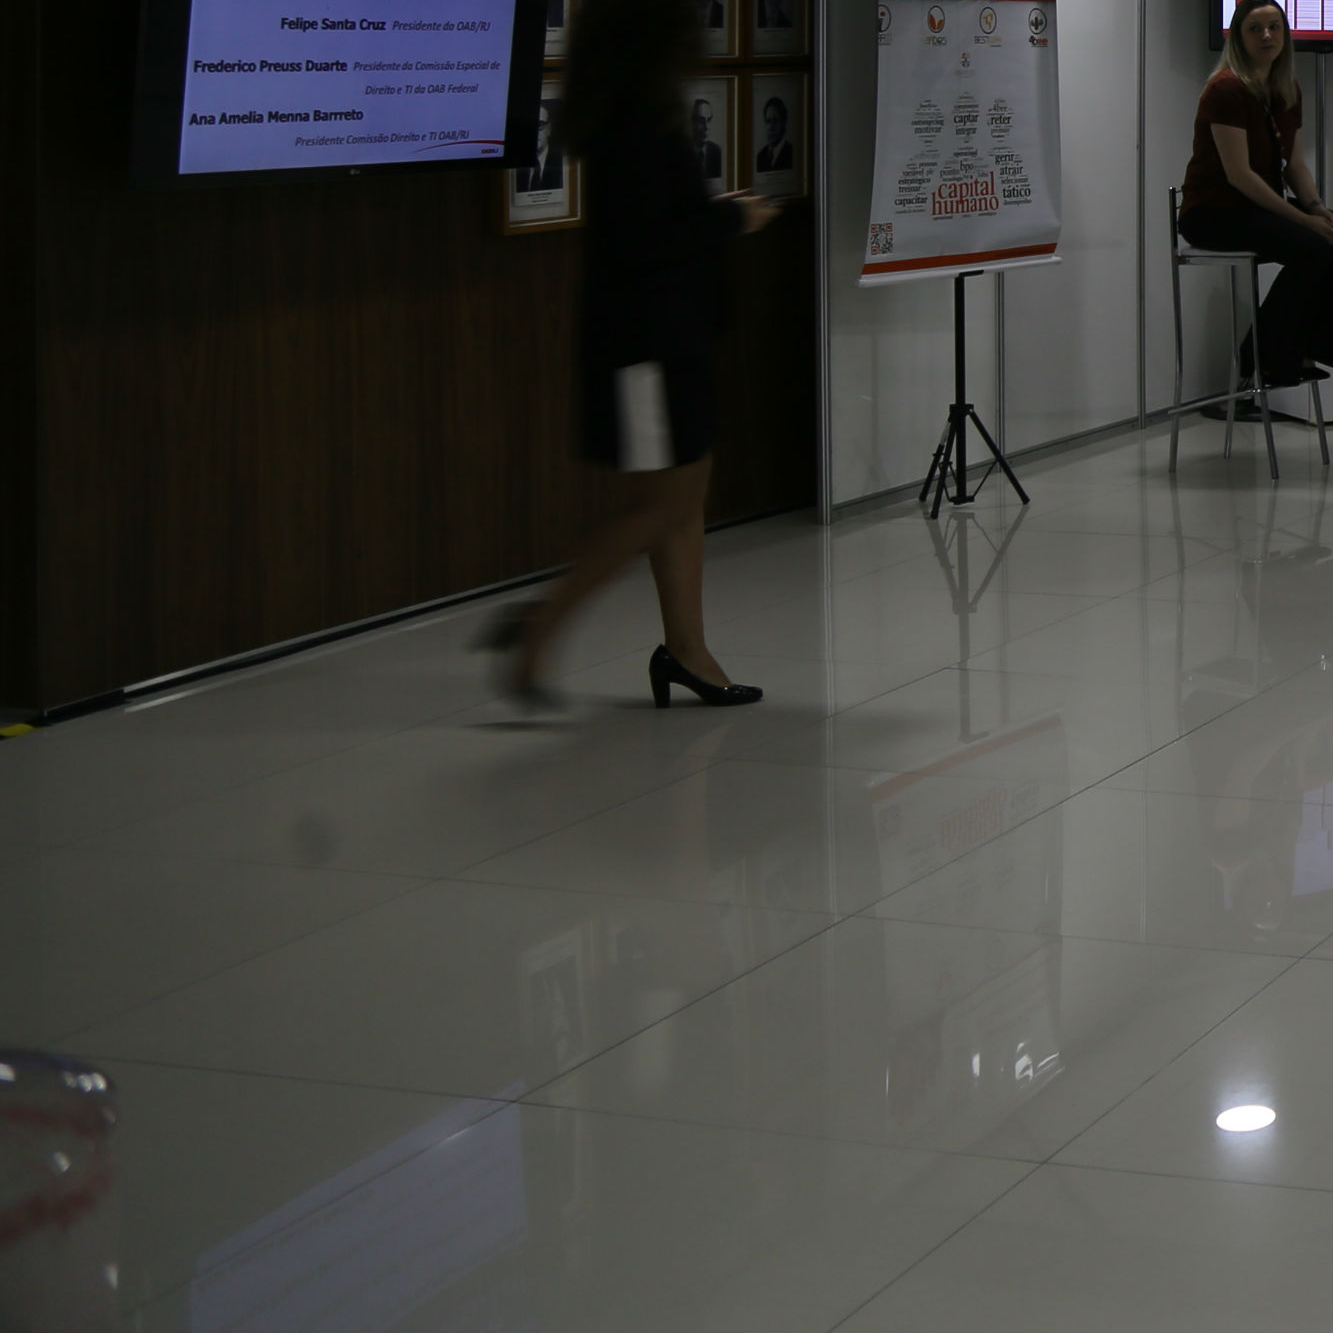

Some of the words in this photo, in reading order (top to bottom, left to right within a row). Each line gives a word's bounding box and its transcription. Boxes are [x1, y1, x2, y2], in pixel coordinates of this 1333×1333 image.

[281, 18, 318, 32] Felipe
[321, 19, 356, 30] Santa
[360, 19, 387, 31] Cruz
[392, 20, 441, 32] Presidente
[443, 21, 455, 32] da
[457, 21, 491, 33] OAB/RJ
[194, 60, 257, 73] Frederico
[260, 60, 302, 73] Preuss
[305, 60, 347, 72] Duarte
[353, 61, 400, 72] Presidente
[415, 60, 455, 71] Comissão
[456, 61, 489, 72] Especial
[365, 84, 396, 95] Direito
[405, 84, 413, 94] TI
[415, 84, 426, 94] da
[428, 84, 446, 94] OAB
[448, 83, 479, 94] Federal
[189, 113, 216, 126] Ana
[219, 111, 264, 125] Amelia
[268, 111, 310, 123] Menna
[953, 114, 979, 126] captar
[990, 115, 1012, 125] reter
[295, 135, 345, 147] Presidente
[346, 133, 388, 145] Comissão
[390, 132, 421, 143] Direito
[429, 131, 437, 141] TI
[438, 130, 469, 141] OAB/RJ
[938, 171, 995, 204] capital
[1003, 185, 1031, 198] tático
[894, 195, 928, 207] capacitar
[932, 193, 999, 216] humano
